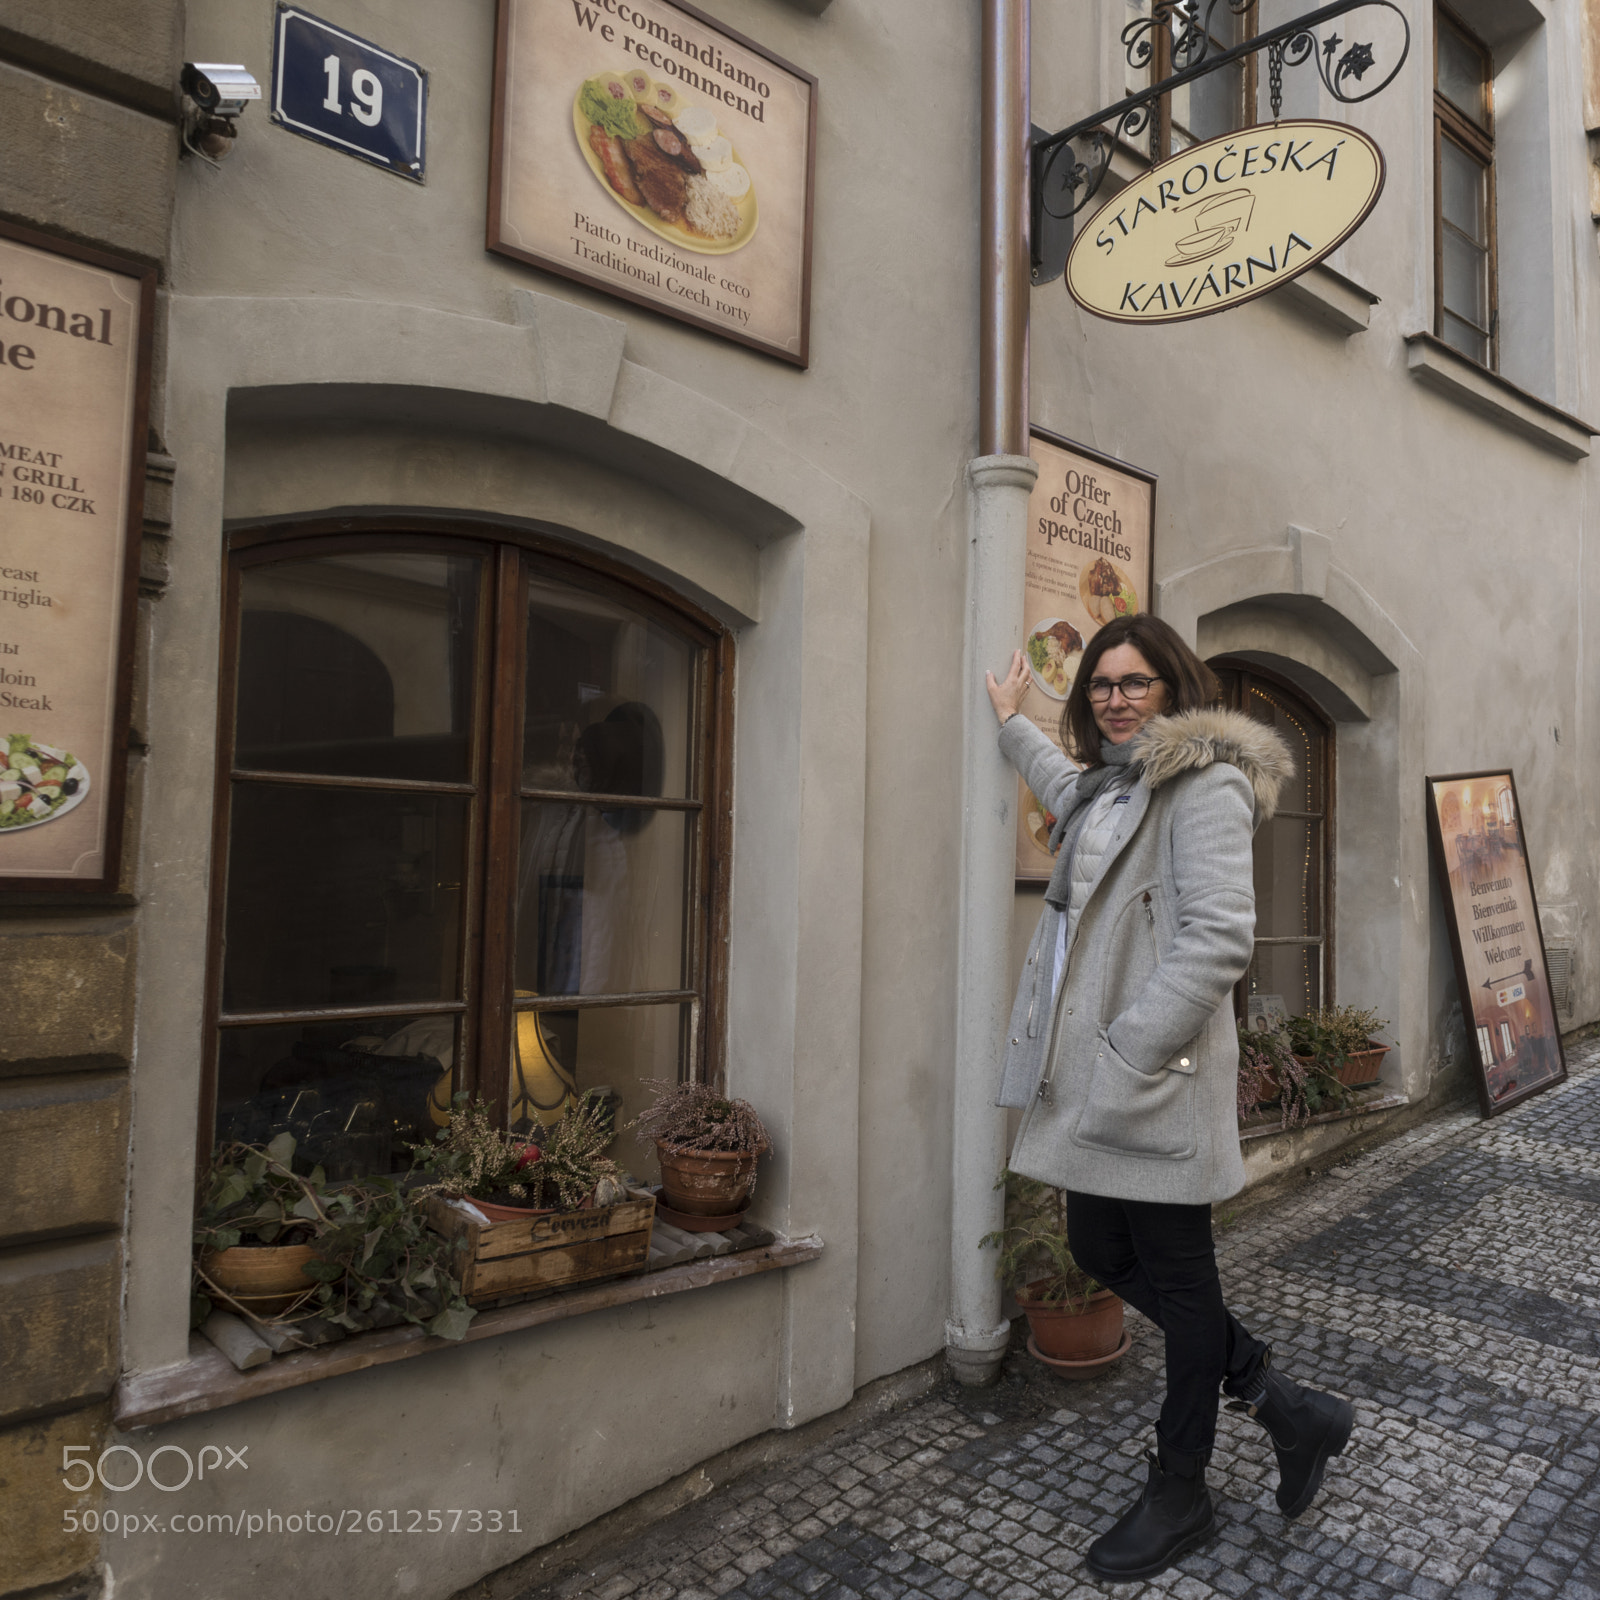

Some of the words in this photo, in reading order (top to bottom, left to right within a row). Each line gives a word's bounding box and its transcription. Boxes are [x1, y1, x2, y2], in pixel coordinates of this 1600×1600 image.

[572, 0, 615, 43] We
[622, 34, 765, 123] recommend
[323, 54, 384, 127] 19
[1096, 138, 1347, 255] STAROČESKÁ
[574, 211, 621, 246] Piatto
[627, 237, 716, 285] tradizionale
[720, 278, 751, 300] ceco
[1119, 231, 1314, 313] KAVÁRNA
[570, 236, 661, 288] Traditional
[666, 277, 711, 308] Czech
[716, 299, 751, 327] rorty
[0, 277, 114, 347] onal
[13, 465, 85, 494] GRILL
[1065, 470, 1111, 507] Offer
[12, 485, 45, 505] 180
[51, 493, 97, 516] CZK
[1050, 492, 1069, 517] of
[1073, 497, 1122, 535] Czech
[1038, 517, 1132, 562] specialities
[0, 566, 40, 583] east
[0, 691, 53, 711] Steak
[1469, 877, 1513, 897] Benvenuto
[1472, 896, 1518, 921] Bienvenida
[1471, 920, 1526, 945] Willkommen
[1484, 945, 1522, 966] Welcome
